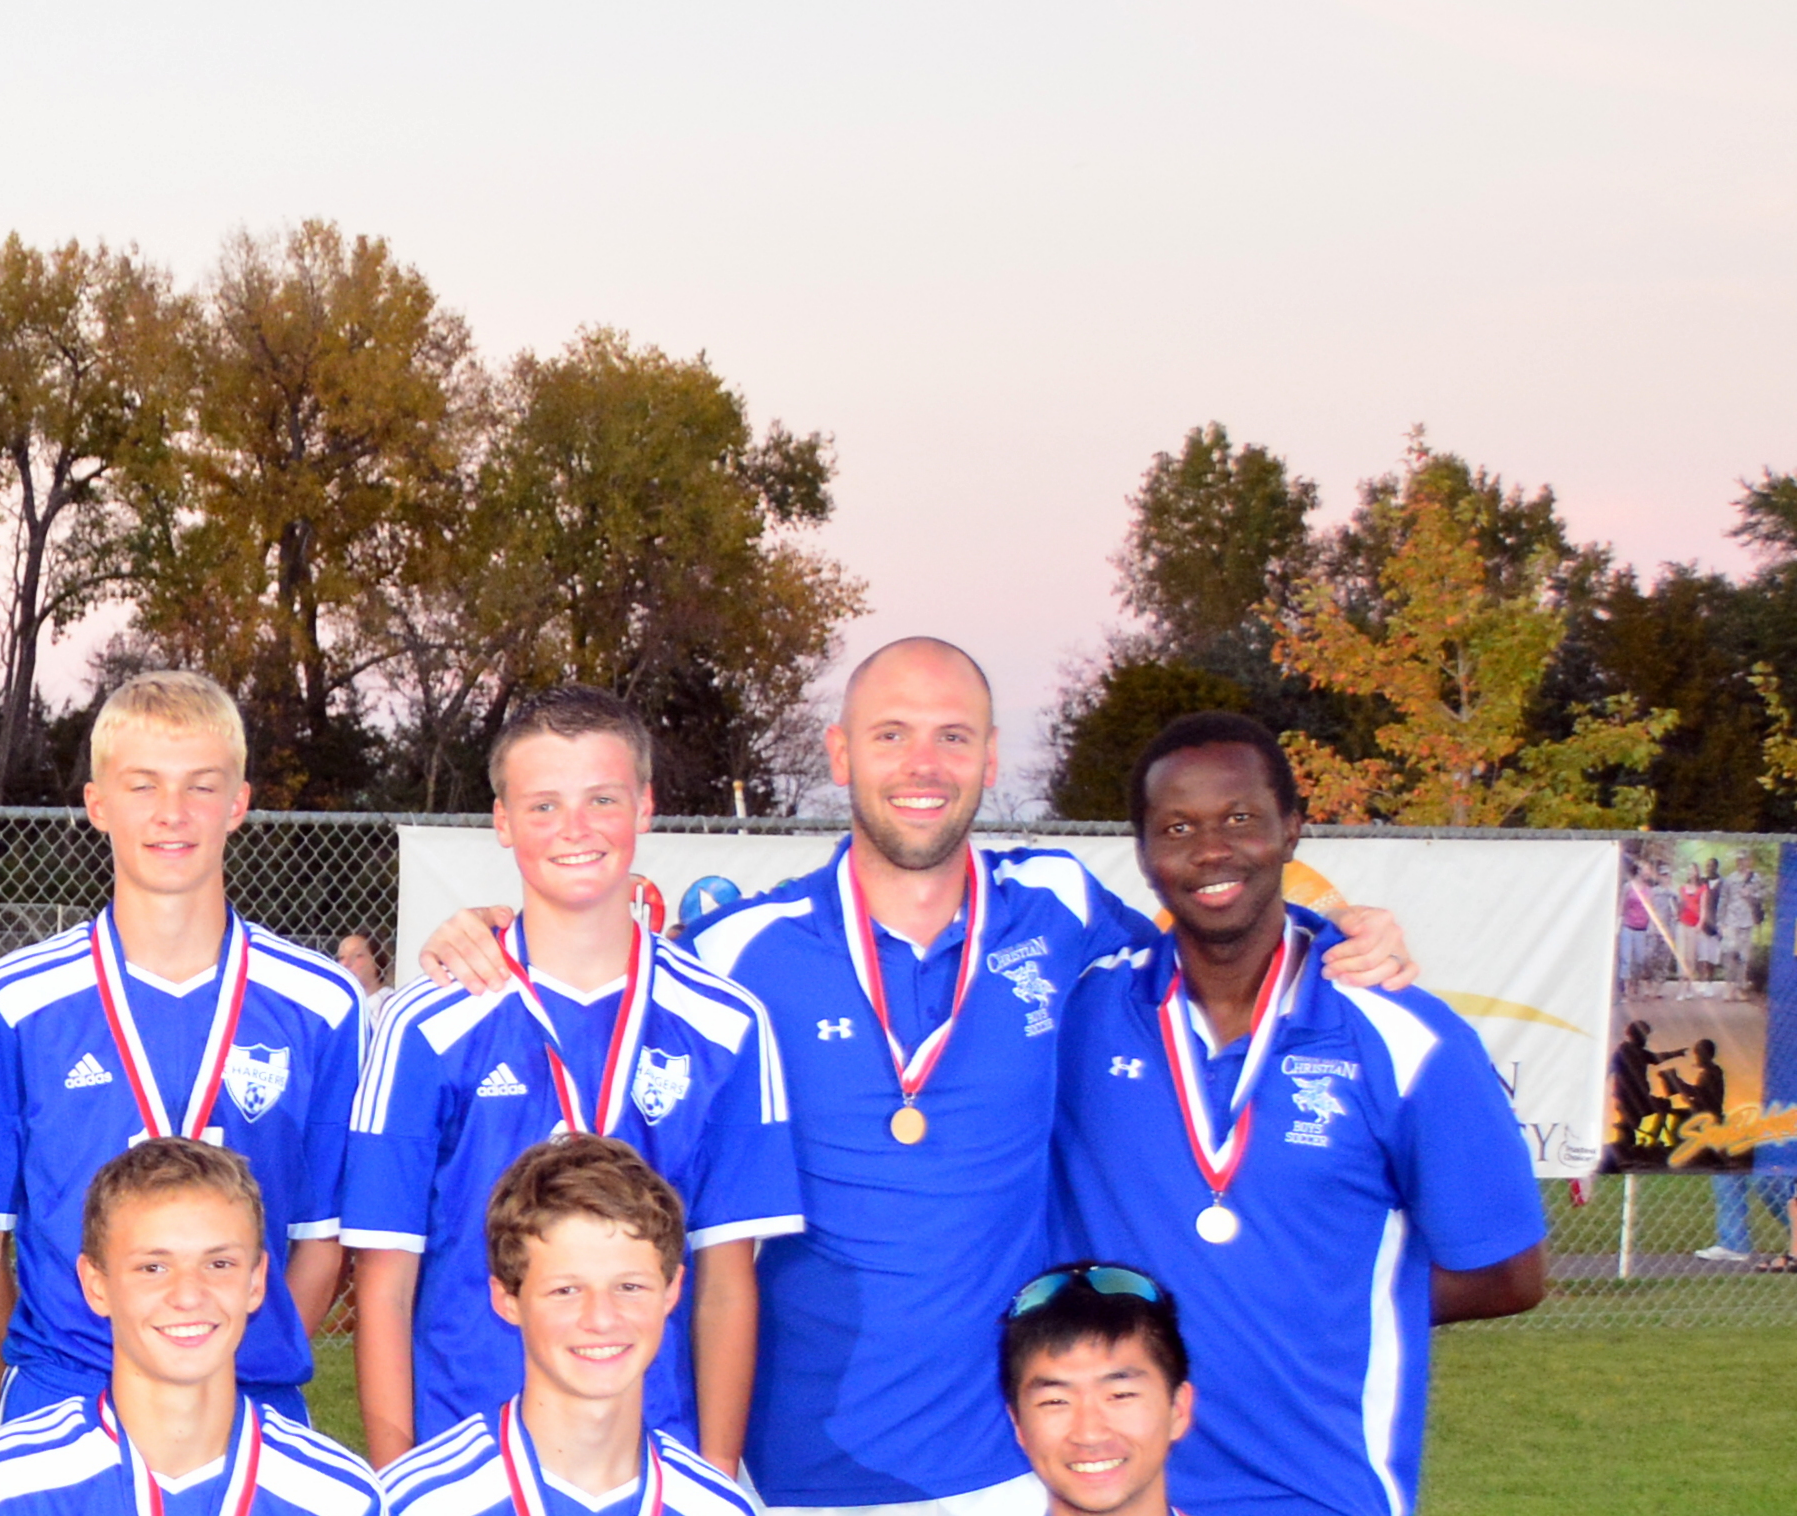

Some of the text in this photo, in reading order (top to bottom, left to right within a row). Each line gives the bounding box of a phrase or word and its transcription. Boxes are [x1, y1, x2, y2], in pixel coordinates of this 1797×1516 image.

[1281, 1055, 1359, 1080] CHRISTIAN
[64, 1071, 113, 1089] adidas
[639, 1063, 685, 1096] HARGERS
[477, 1083, 528, 1098] adidas
